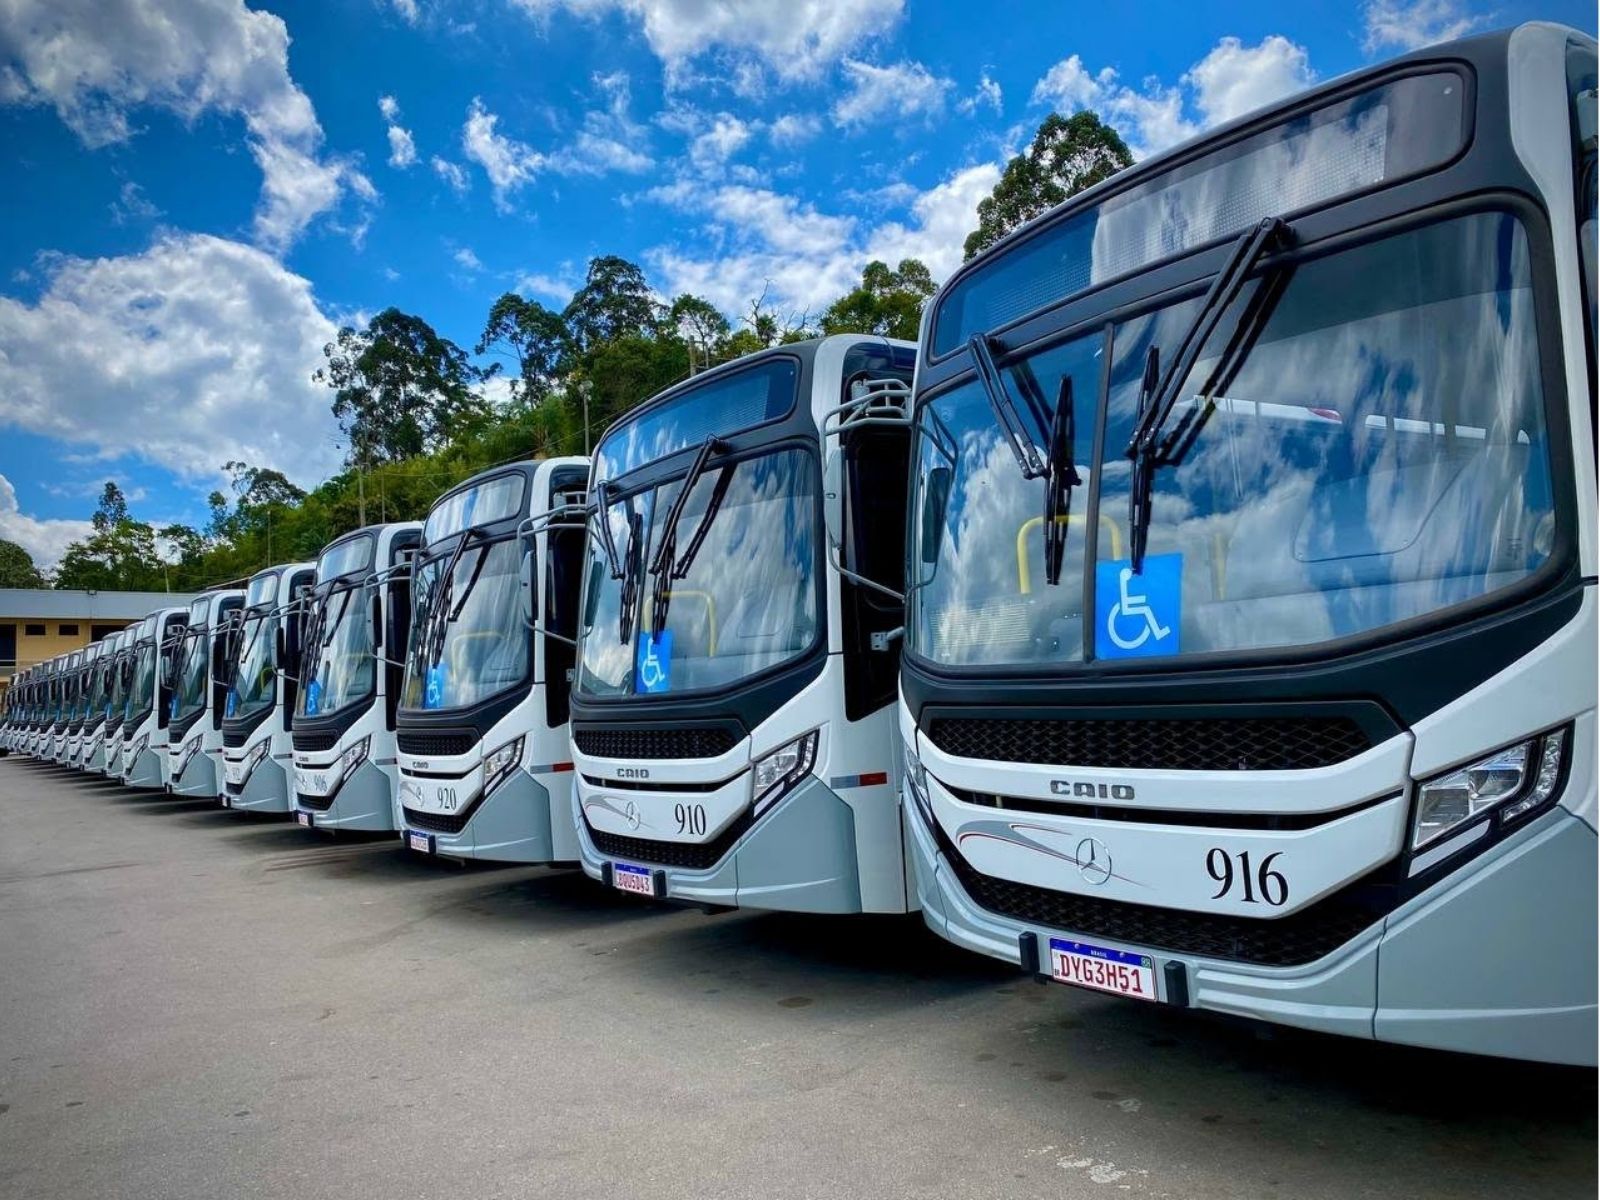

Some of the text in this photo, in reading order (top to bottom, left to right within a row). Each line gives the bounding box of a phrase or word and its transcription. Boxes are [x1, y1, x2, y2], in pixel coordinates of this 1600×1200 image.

[616, 768, 650, 779] CAIO
[438, 787, 457, 810] 920
[1050, 780, 1136, 800] CAIO
[674, 803, 706, 836] 910
[1206, 848, 1289, 906] 916
[1059, 954, 1143, 993] DYG3H51
